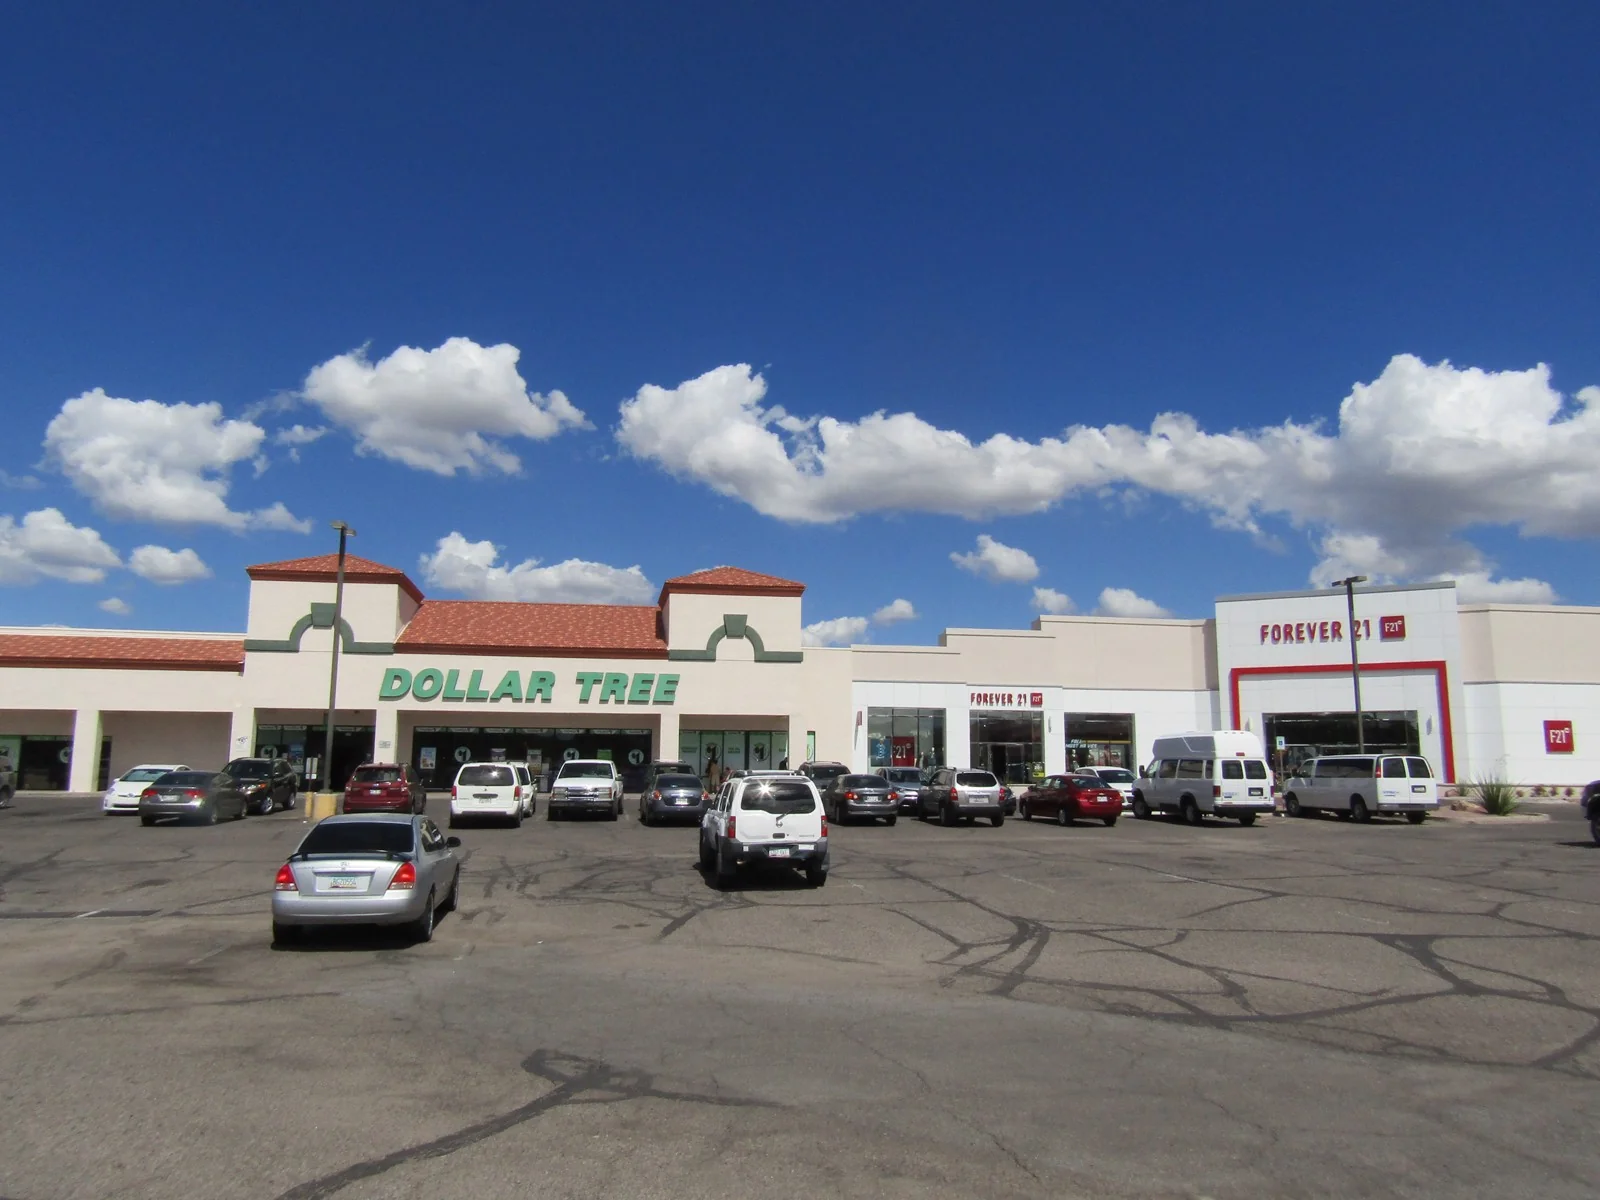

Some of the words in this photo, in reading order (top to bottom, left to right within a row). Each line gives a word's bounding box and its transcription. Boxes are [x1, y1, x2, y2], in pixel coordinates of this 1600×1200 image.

[1260, 621, 1342, 644] FOREVER
[1352, 620, 1370, 641] 21
[1384, 621, 1402, 633] F21
[379, 668, 556, 703] DOLLAR
[575, 672, 680, 705] TREE
[970, 693, 1013, 706] FOREVER
[1017, 693, 1027, 706] 21
[1549, 728, 1570, 744] F21
